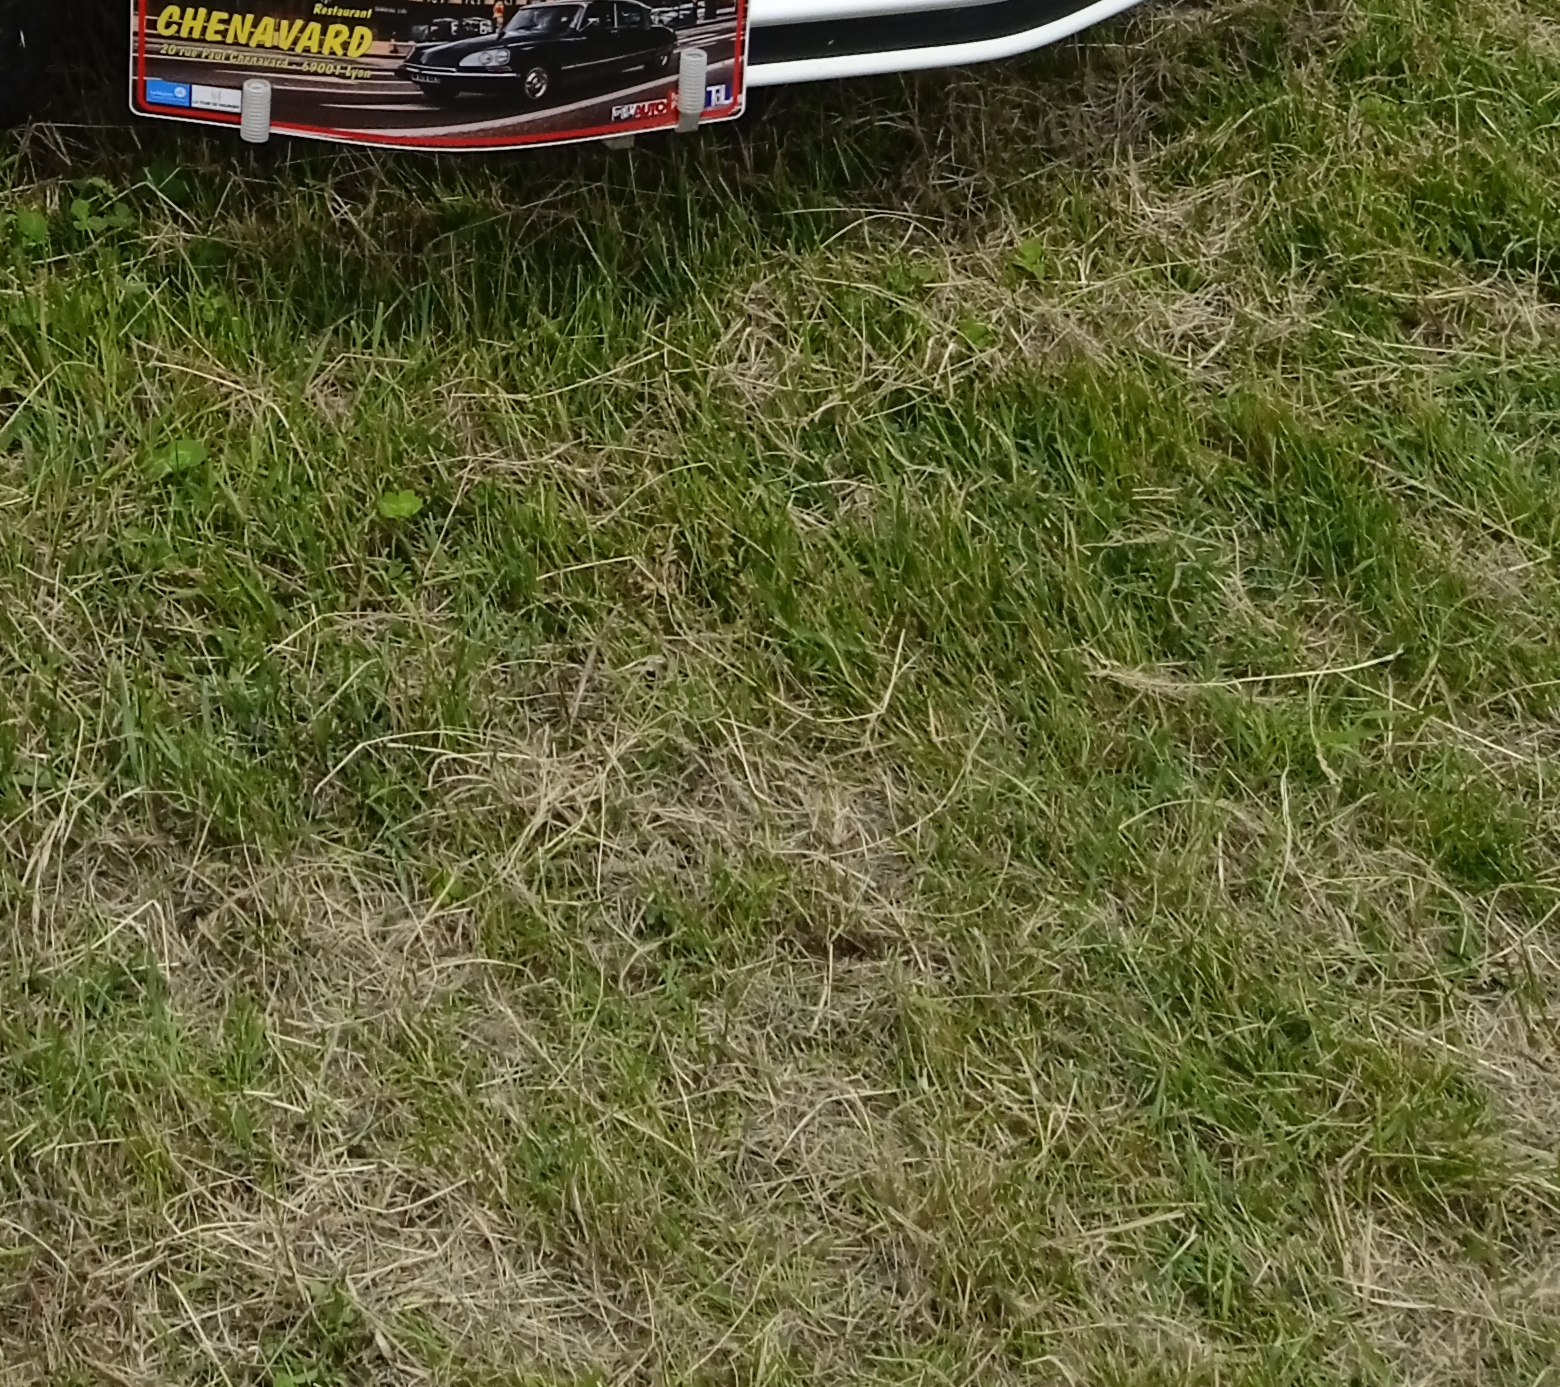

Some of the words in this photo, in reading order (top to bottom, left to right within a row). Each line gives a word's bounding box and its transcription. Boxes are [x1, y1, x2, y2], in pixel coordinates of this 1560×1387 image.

[312, 2, 373, 19] Restaurant
[156, 4, 374, 59] CHENAVARD
[159, 43, 177, 56] 20
[178, 46, 198, 59] rue
[200, 48, 227, 62] Paul
[228, 51, 290, 70] Chenavard
[301, 59, 341, 76] 69001
[344, 64, 372, 81] Lyon
